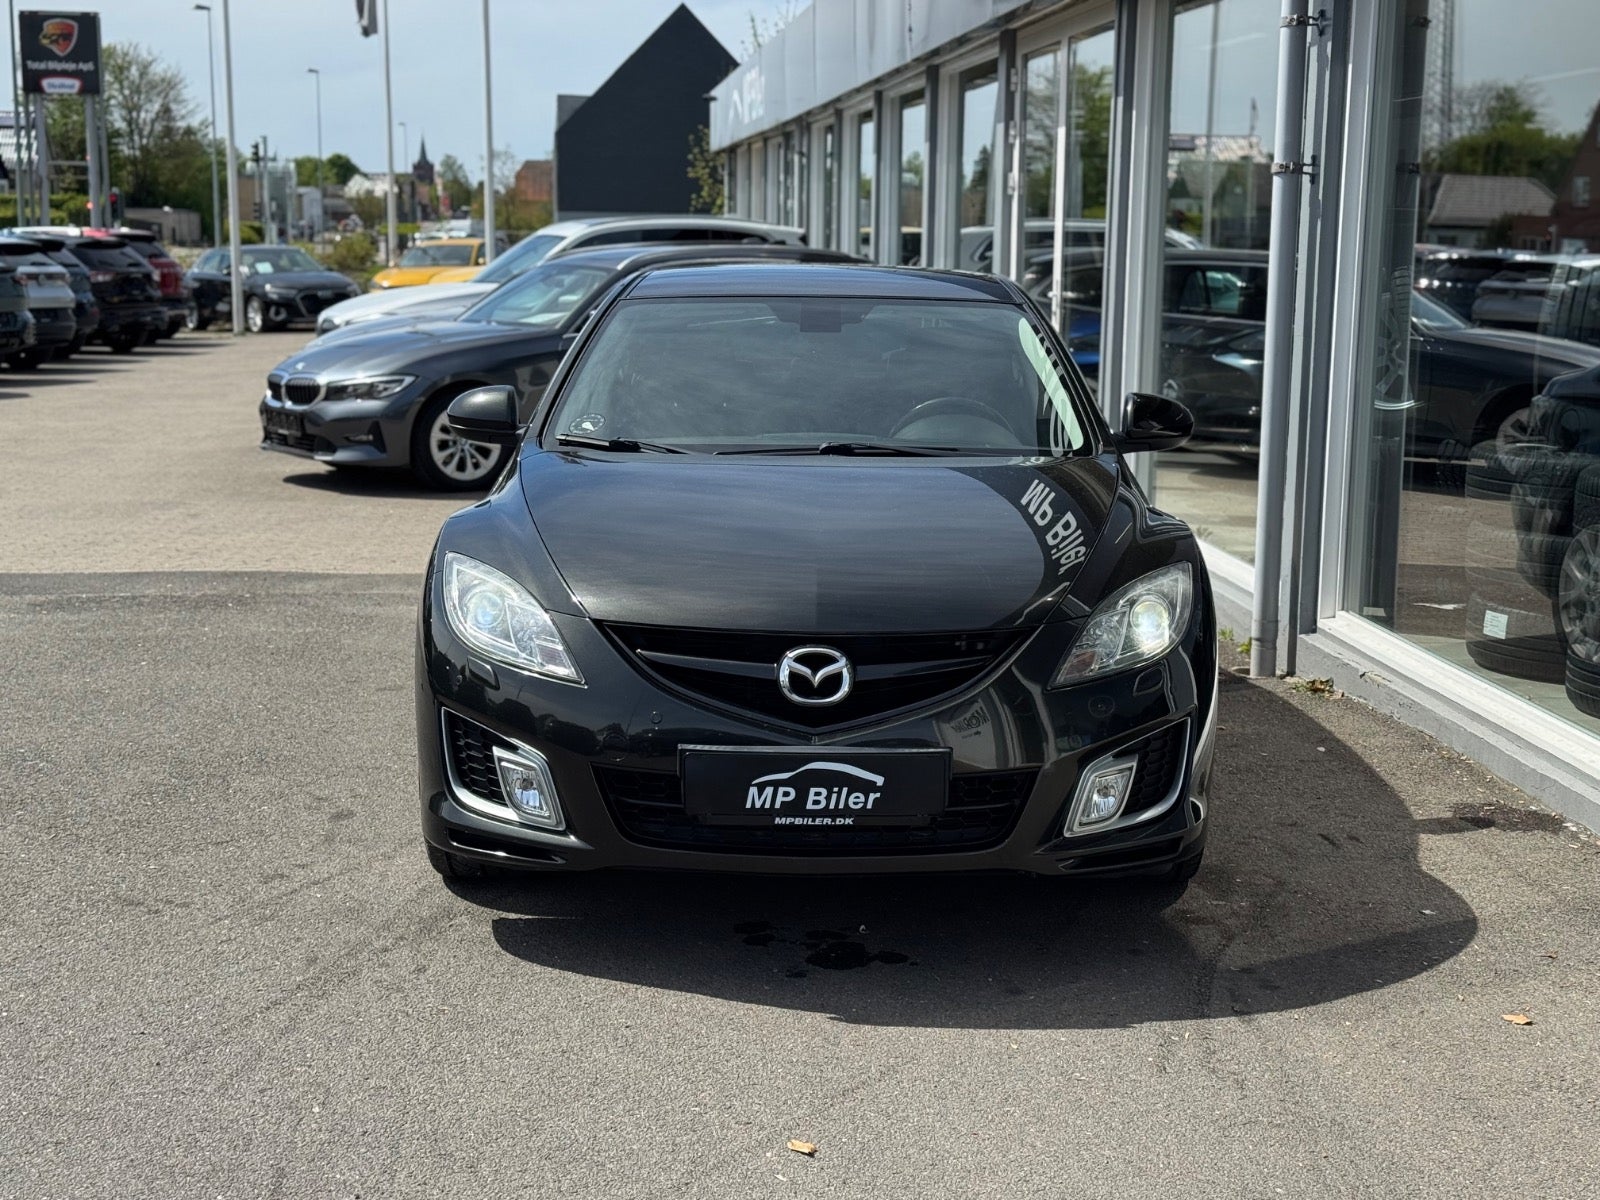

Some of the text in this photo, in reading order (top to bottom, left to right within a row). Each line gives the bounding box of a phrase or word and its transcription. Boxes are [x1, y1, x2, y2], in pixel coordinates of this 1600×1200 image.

[745, 786, 880, 810] MP Biler
[774, 817, 854, 825] MPBILER.DK
